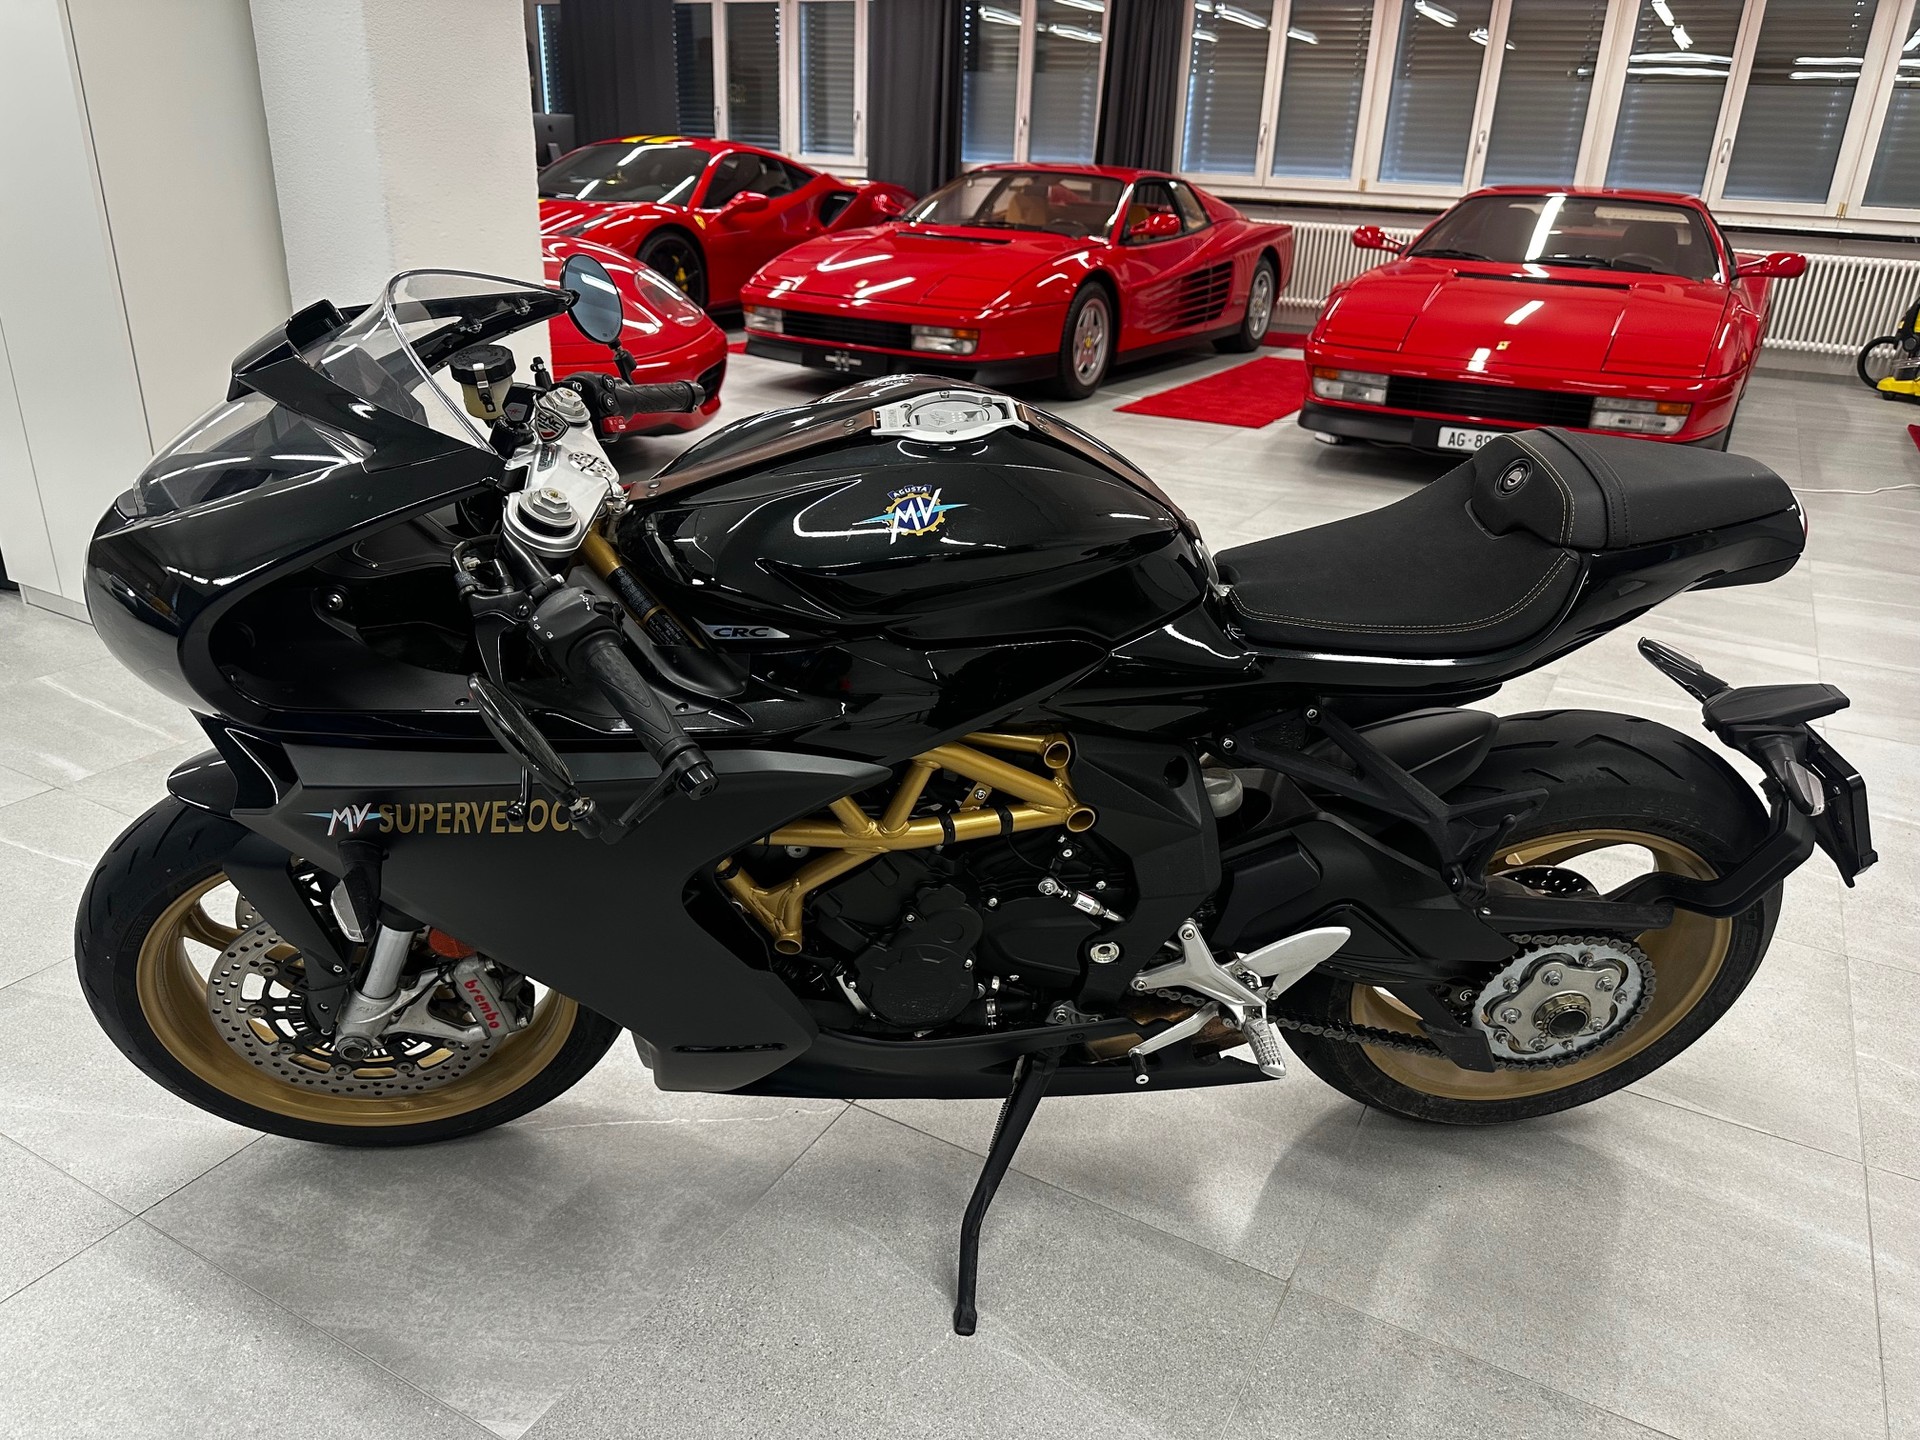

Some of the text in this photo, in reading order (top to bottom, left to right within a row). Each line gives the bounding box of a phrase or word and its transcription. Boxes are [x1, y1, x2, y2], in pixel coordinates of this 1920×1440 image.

[893, 486, 928, 498] AGUSTA
[890, 488, 942, 544] MV
[713, 627, 769, 637] CRC
[327, 802, 373, 836] MV
[464, 979, 500, 1029] brembo
